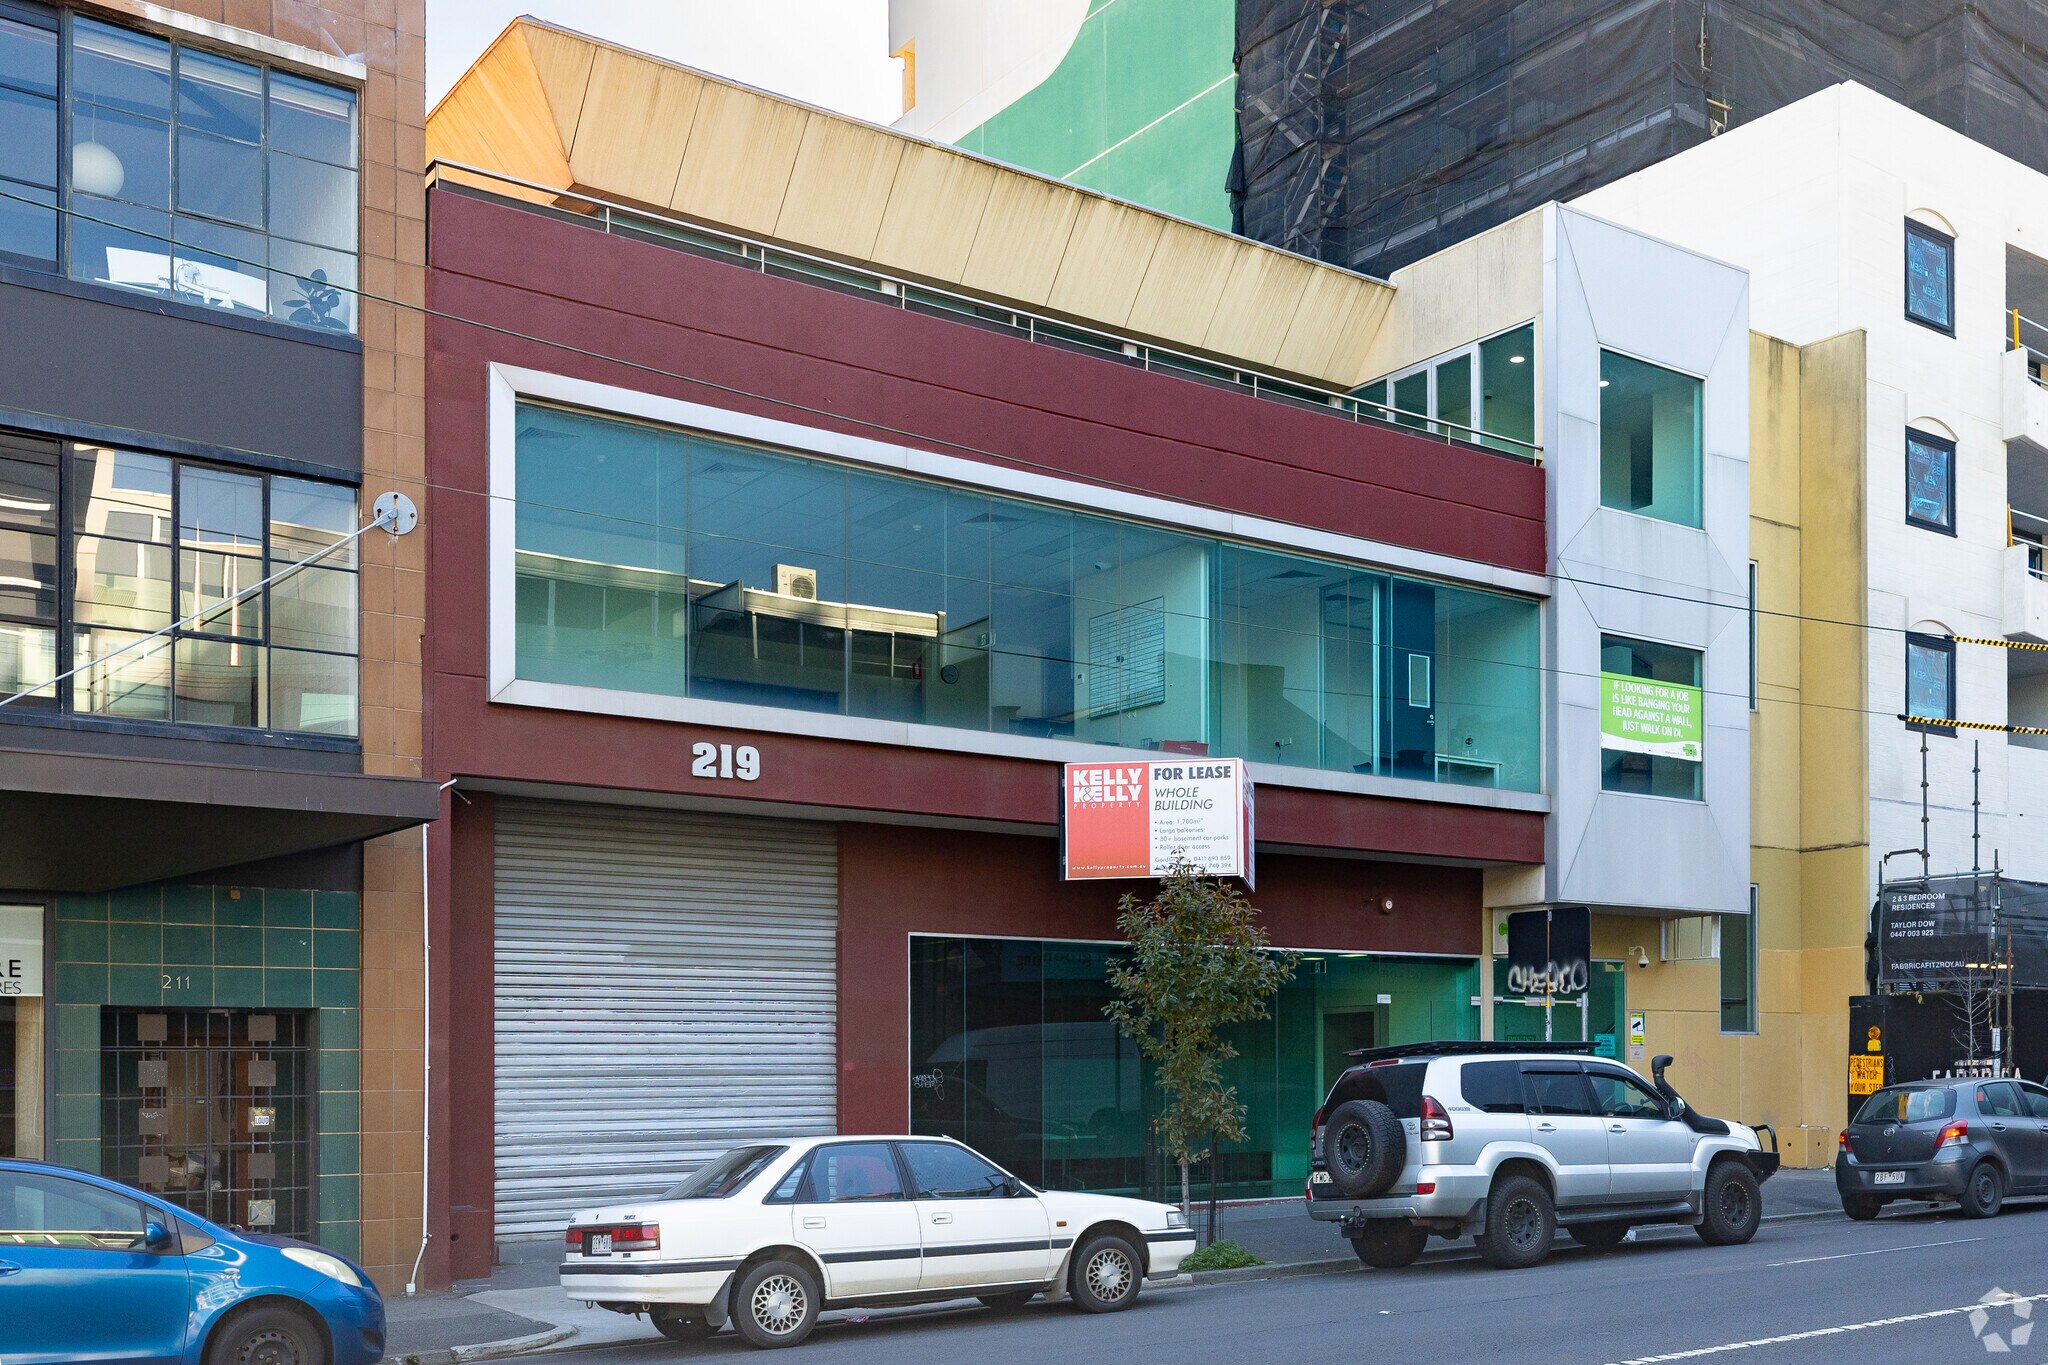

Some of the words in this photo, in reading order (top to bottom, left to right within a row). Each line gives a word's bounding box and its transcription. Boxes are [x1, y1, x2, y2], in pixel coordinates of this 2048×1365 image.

[1613, 680, 1619, 690] IF
[1621, 682, 1654, 696] LOOKING
[1655, 687, 1668, 697] FOR
[1670, 690, 1676, 699] A
[1677, 691, 1689, 701] JOB
[1612, 693, 1619, 703] IS
[1621, 695, 1636, 706] LIKE
[1638, 697, 1670, 711] BANGING
[1671, 703, 1690, 714] YOUR
[1612, 706, 1632, 717] HEAD
[1633, 709, 1664, 723] AGAINST
[1665, 713, 1671, 723] A
[1671, 715, 1692, 728] WALL,
[1622, 720, 1639, 732] JUST
[1640, 723, 1660, 735] WALK
[1661, 726, 1672, 737] ON
[692, 742, 760, 781] 219
[1073, 768, 1143, 786] KELLY
[1154, 767, 1183, 780] FOR
[1188, 766, 1231, 779] LEASE
[1155, 787, 1199, 798] WHOLE
[1154, 799, 1213, 811] BUILDING
[1908, 893, 1945, 901] BEDROOM
[1891, 902, 1936, 911] RESIDENCES
[1890, 921, 1917, 929] TAYLOR
[1918, 920, 1935, 928] DOW
[1890, 930, 1906, 938] 0447
[1921, 929, 1934, 937] 923
[1891, 961, 1965, 970] FABBRICAFITZROY.AU
[162, 974, 190, 989] 211
[1850, 1057, 1883, 1068] PEDESTRIANS
[1856, 1070, 1878, 1080] WATCH
[1850, 1083, 1866, 1092] YOUR
